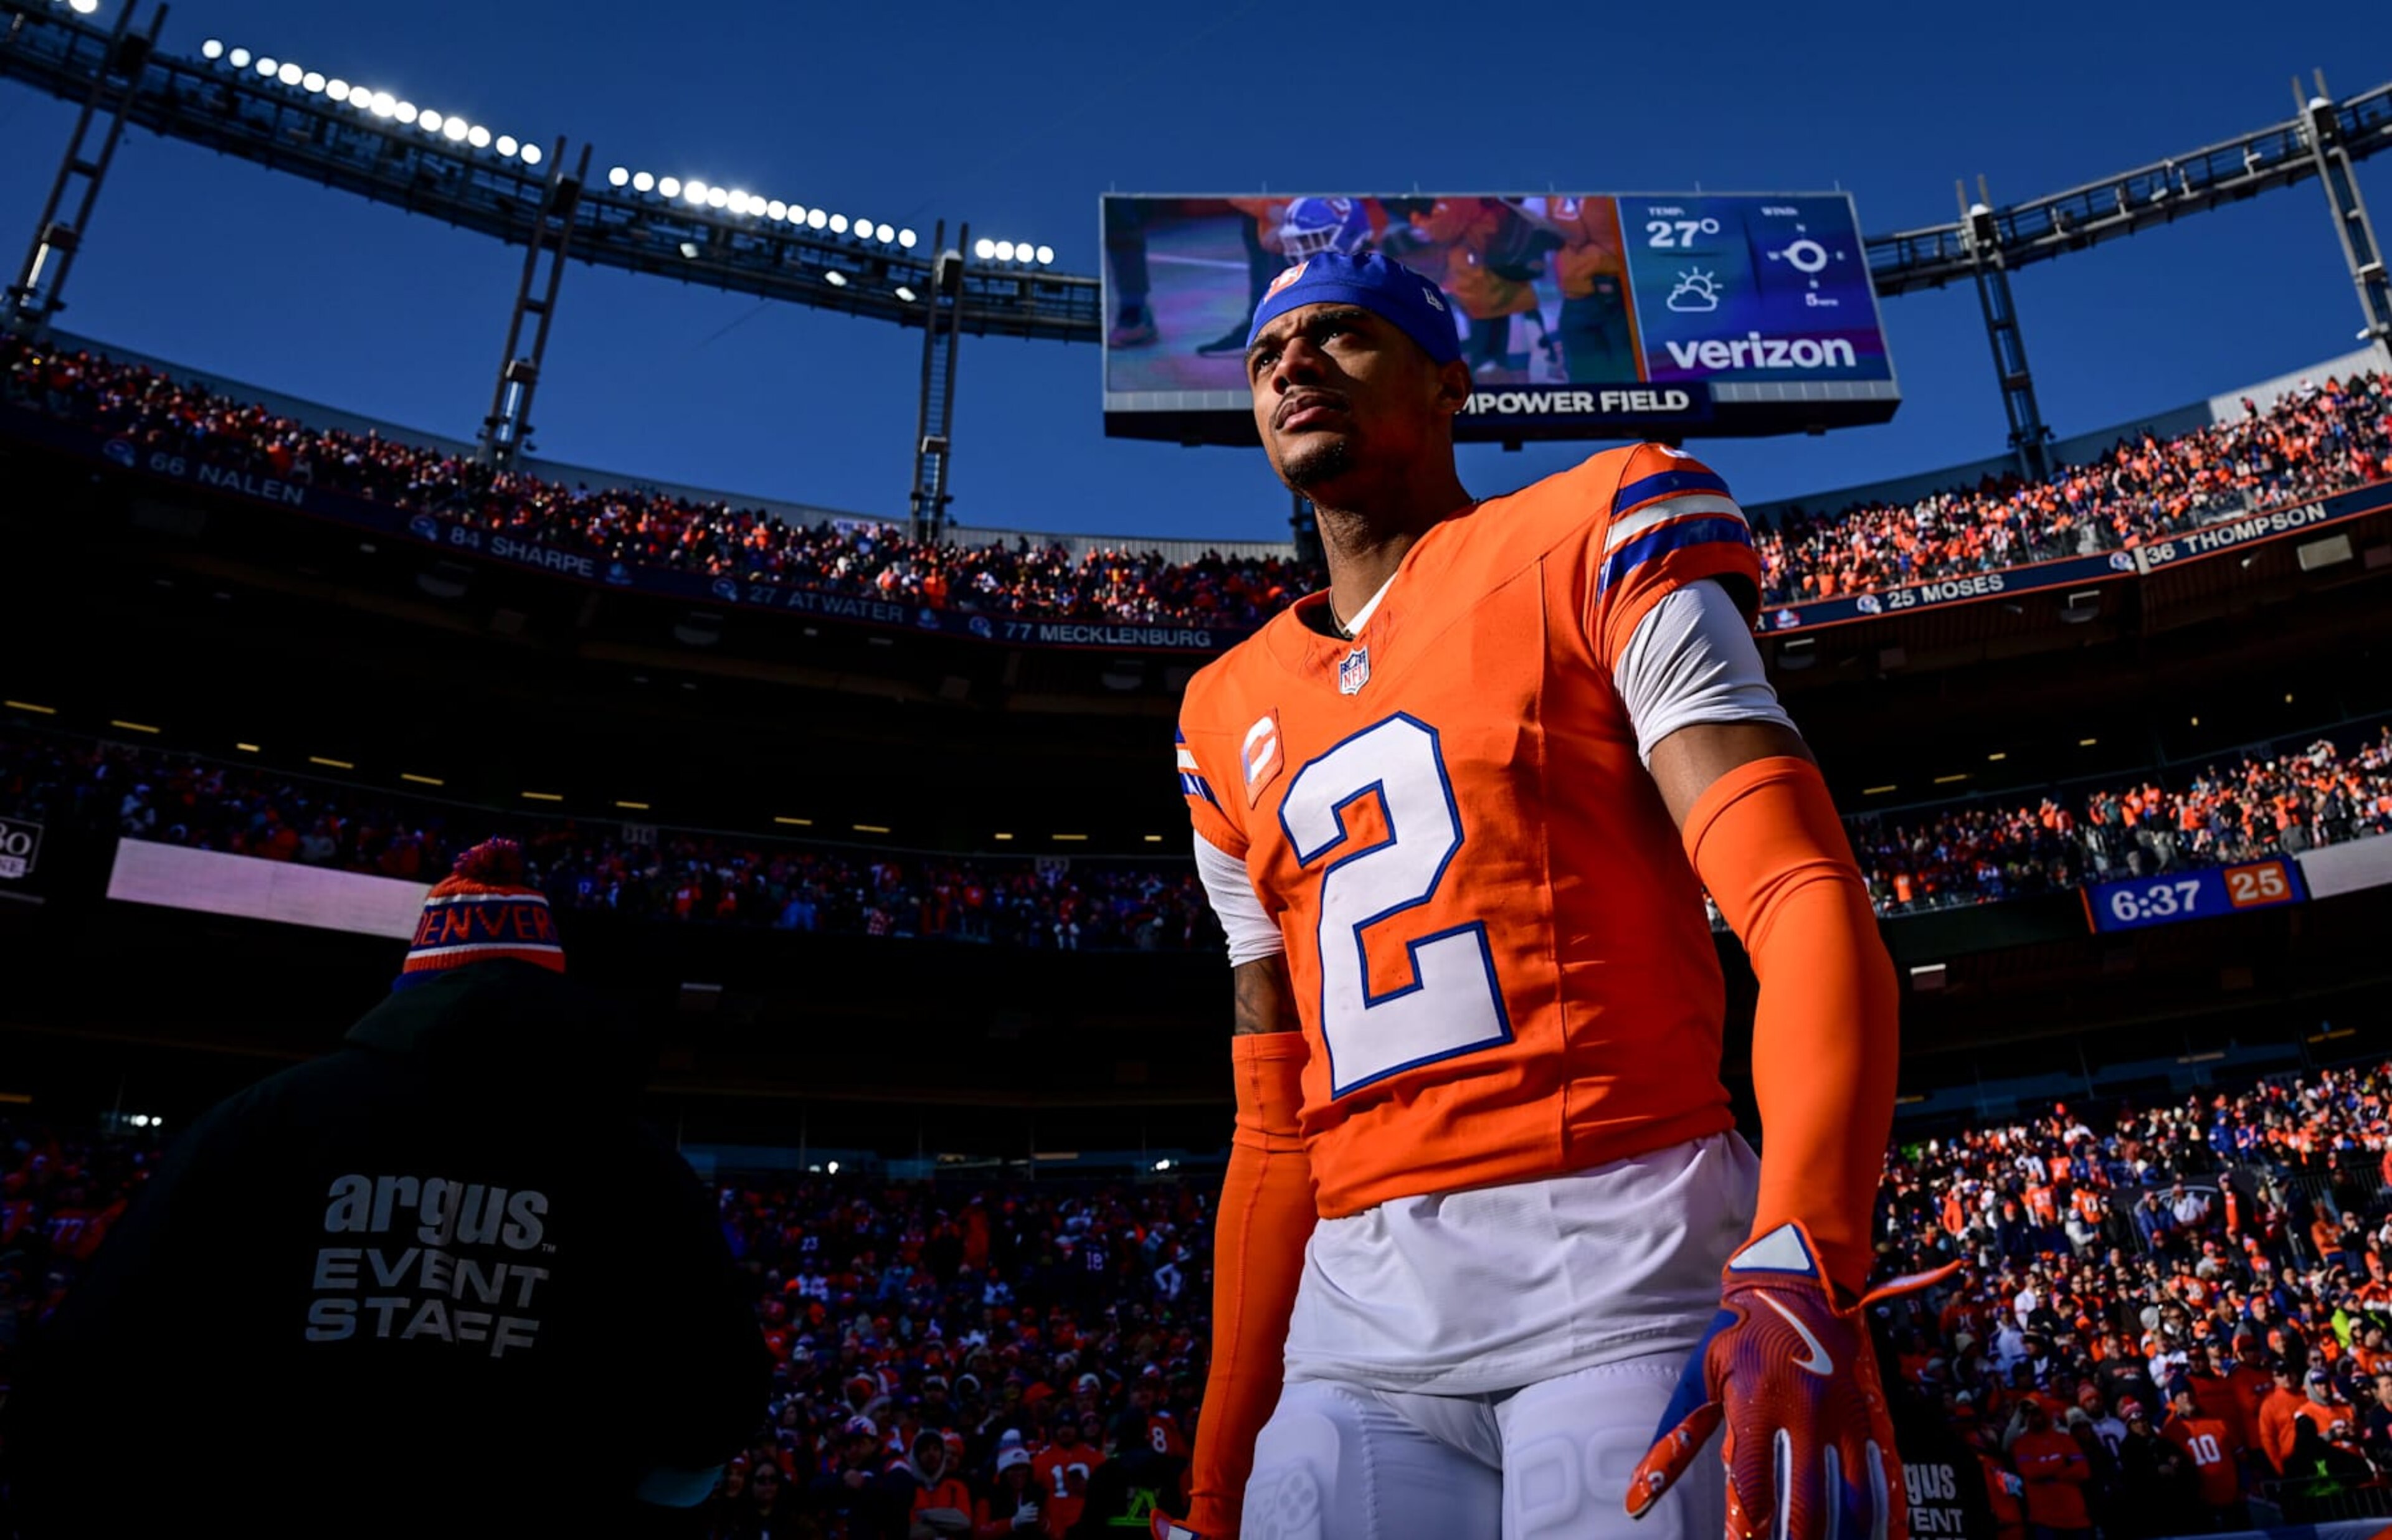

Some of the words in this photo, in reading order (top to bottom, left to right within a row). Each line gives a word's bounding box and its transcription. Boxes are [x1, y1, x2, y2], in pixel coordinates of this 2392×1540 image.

[1665, 331, 1857, 370] verizon
[1600, 389, 1690, 412] FIELD
[150, 451, 187, 477] 66
[196, 461, 305, 506] NALEN
[2183, 501, 2327, 554] THOMPSON
[448, 524, 481, 549] 84
[489, 534, 594, 579] SHARPE
[748, 584, 778, 604] 27
[787, 590, 904, 623] ATWATER
[1887, 588, 1915, 608] 25
[1921, 572, 2005, 603] MOSES
[1004, 622, 1032, 641] 77
[1039, 624, 1212, 647] MECKLENBURG
[1344, 665, 1364, 688] NFL
[2111, 879, 2201, 922] 6:37
[2231, 867, 2285, 902] 25
[412, 905, 558, 946] DENVER
[1278, 711, 1513, 1100] 2
[324, 1173, 549, 1251] argus
[311, 1246, 549, 1308] EVENT
[305, 1296, 540, 1358] STAFF
[1151, 1425, 1167, 1454] 8
[2187, 1434, 2221, 1467] 10
